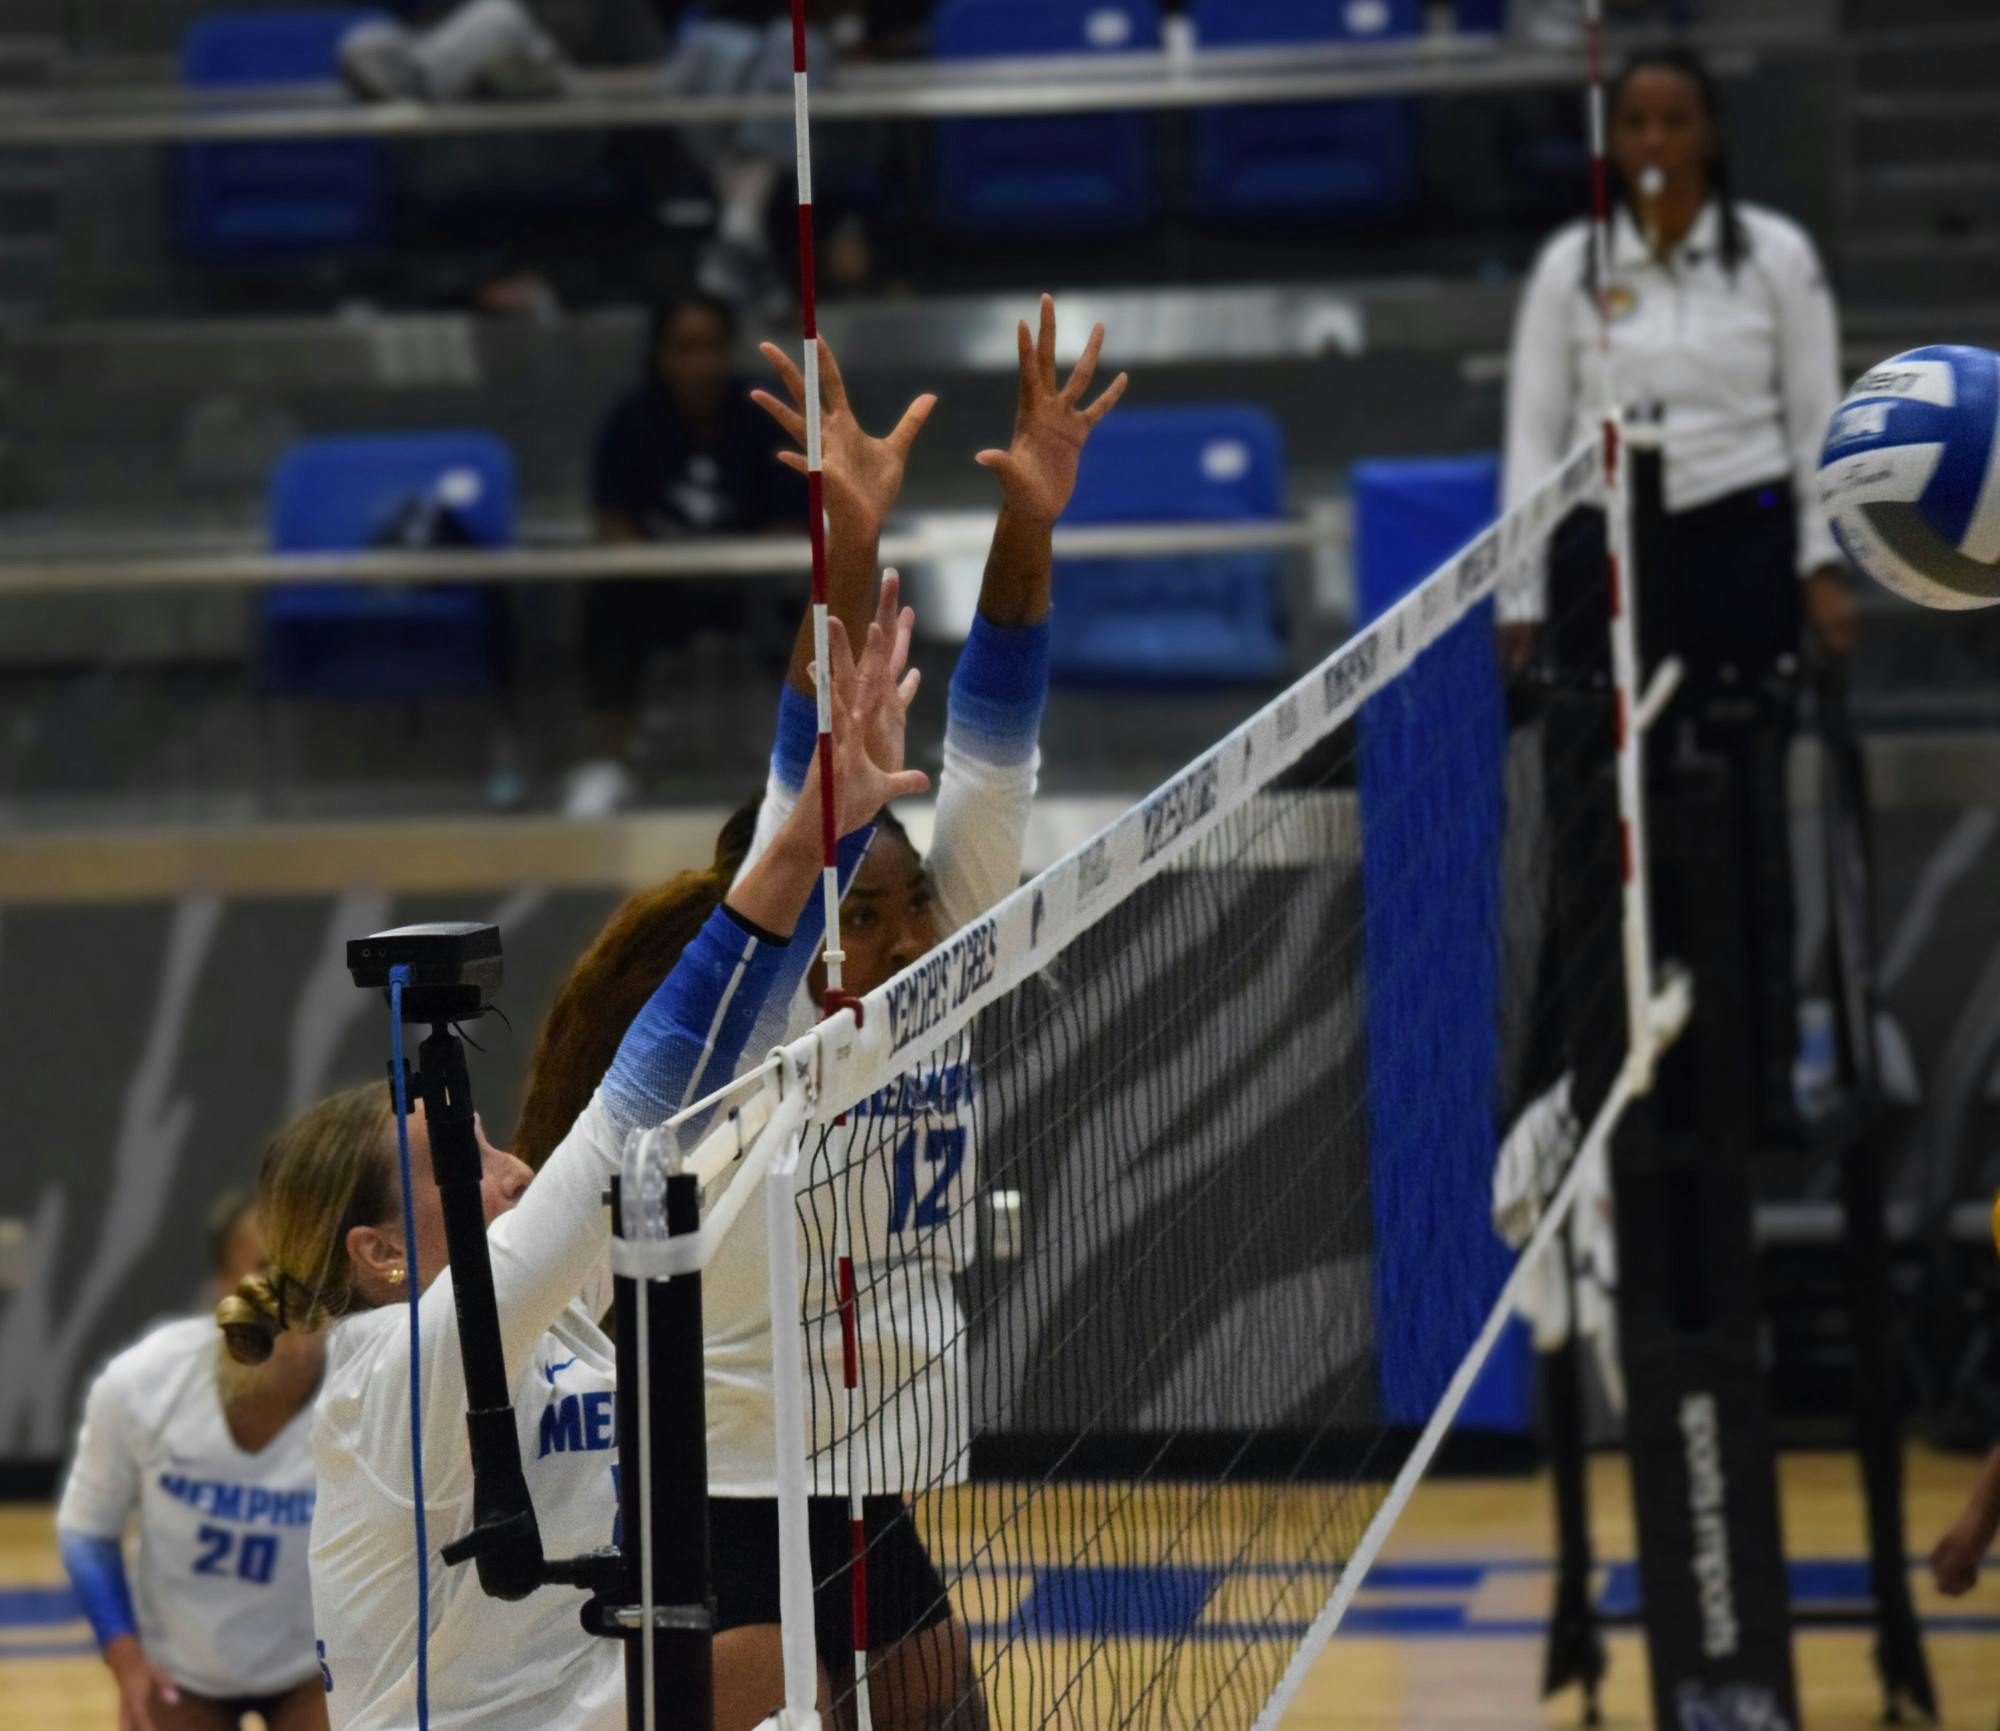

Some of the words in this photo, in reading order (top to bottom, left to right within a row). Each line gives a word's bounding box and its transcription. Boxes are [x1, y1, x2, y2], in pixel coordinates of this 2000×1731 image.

[889, 1125, 967, 1233] 12
[537, 1391, 618, 1460] ME
[192, 1524, 279, 1585] 20
